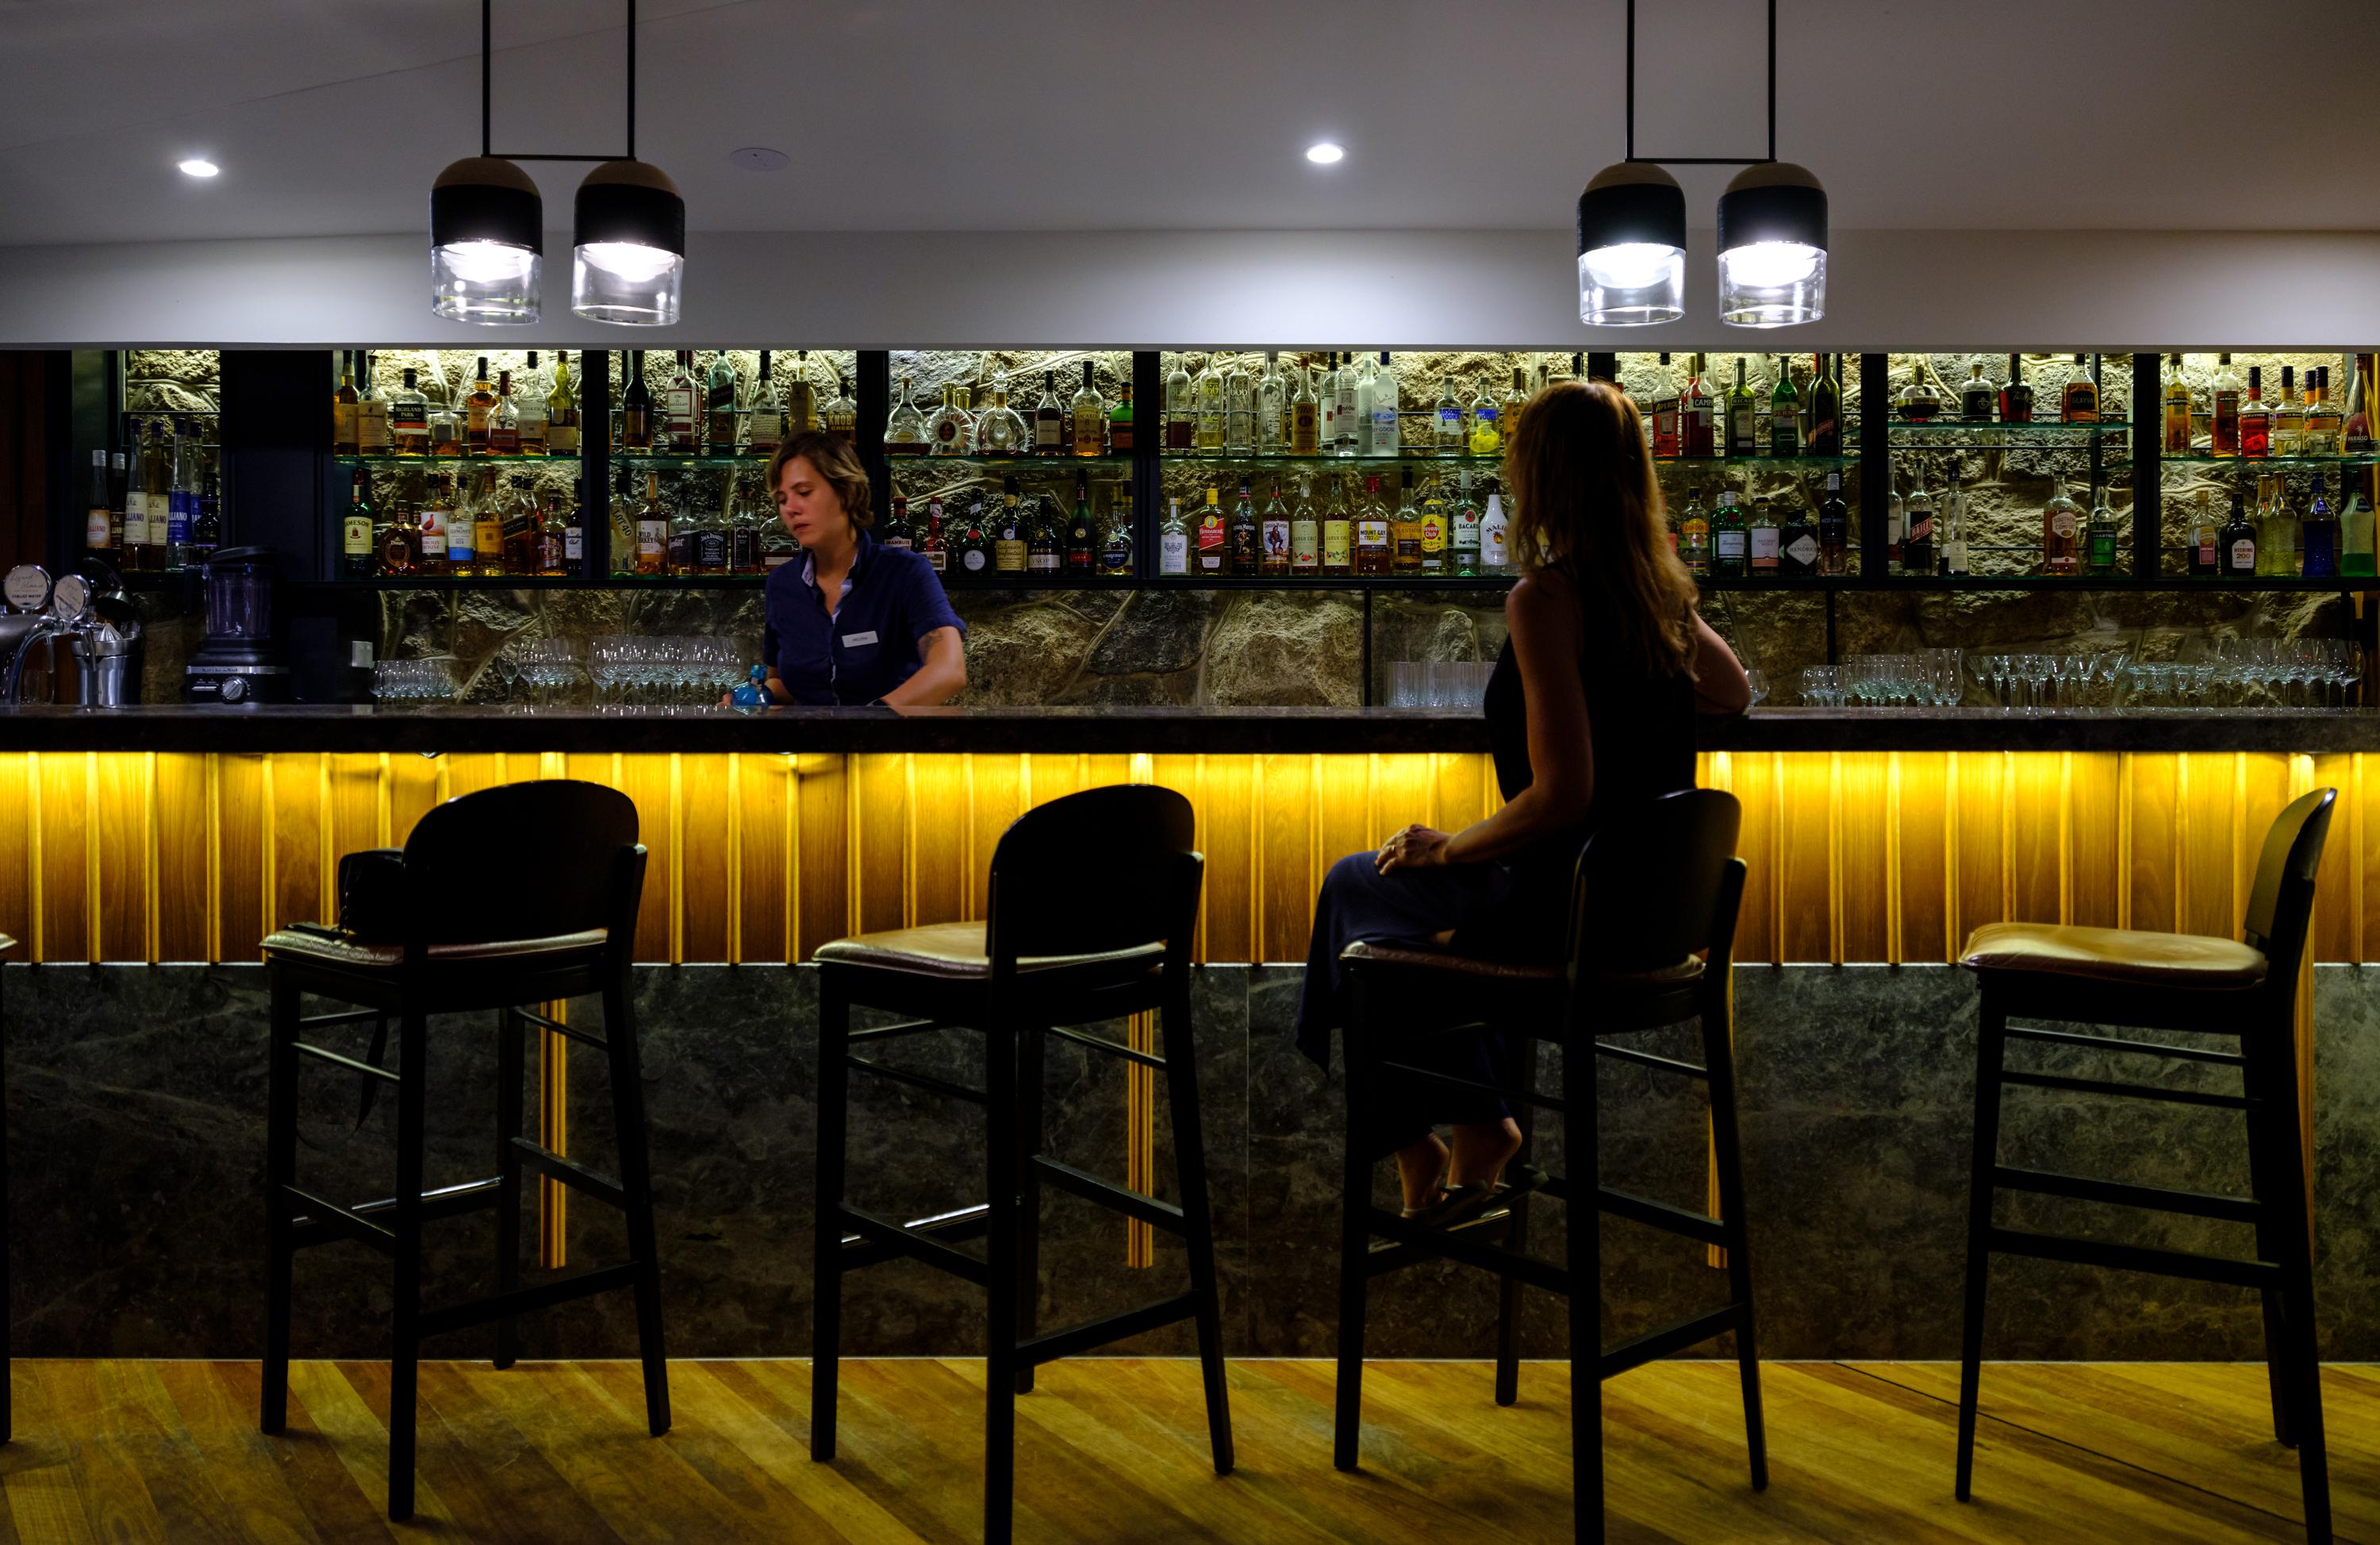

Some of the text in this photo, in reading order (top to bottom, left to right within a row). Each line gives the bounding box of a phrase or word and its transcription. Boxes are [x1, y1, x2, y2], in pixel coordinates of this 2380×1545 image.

[828, 414, 851, 425] KNOB
[125, 513, 144, 521] LLIANO
[149, 514, 166, 524] LLIANO
[168, 512, 188, 521] LLIANO
[1485, 524, 1507, 534] MALI
